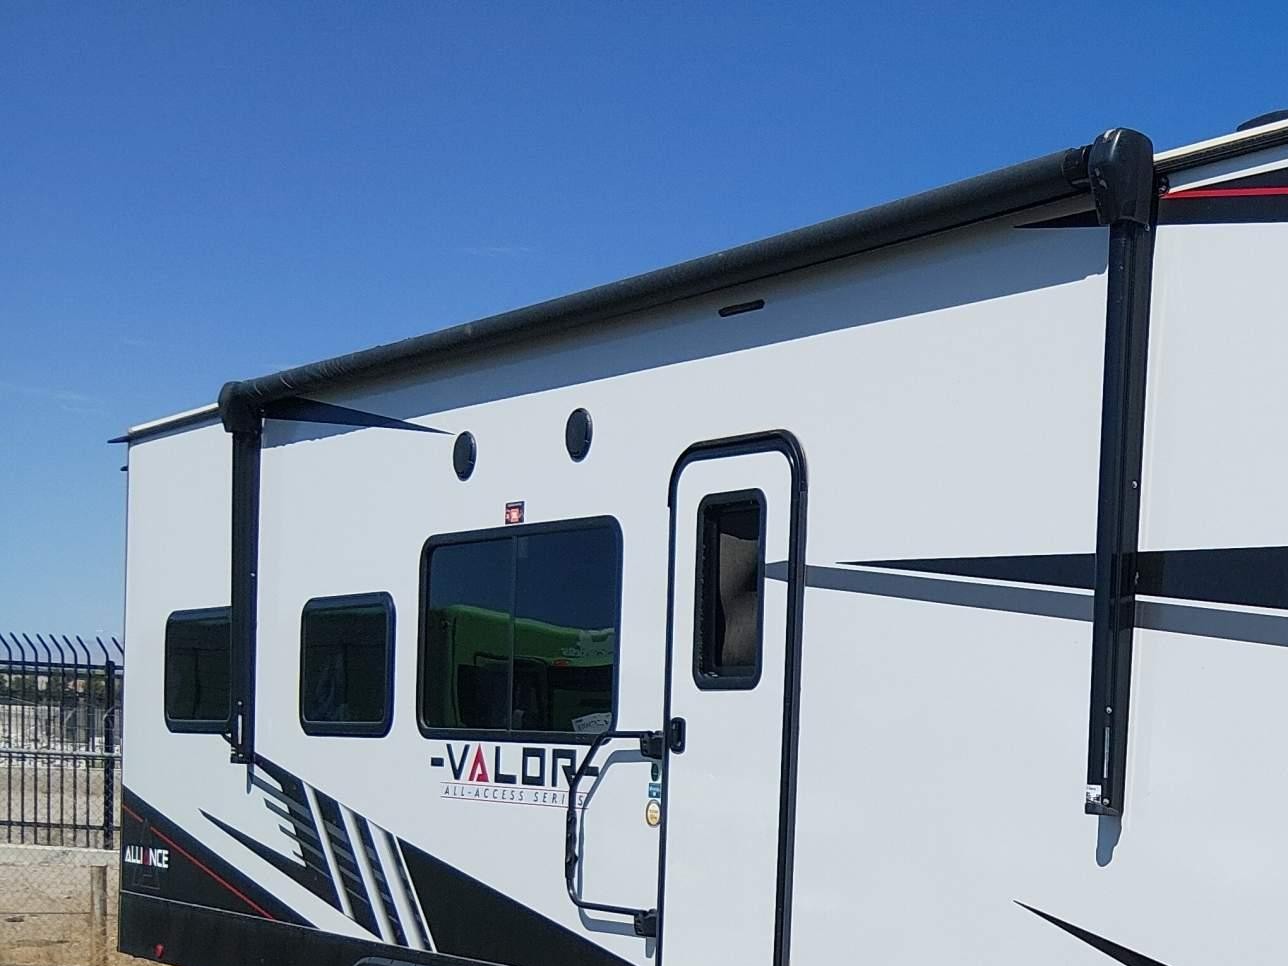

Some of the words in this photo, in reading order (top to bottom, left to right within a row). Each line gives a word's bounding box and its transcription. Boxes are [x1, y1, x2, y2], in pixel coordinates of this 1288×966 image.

[444, 786, 524, 801] ALL-ACCESS
[533, 792, 584, 807] SERIS
[125, 845, 169, 869] ALLIANCE
